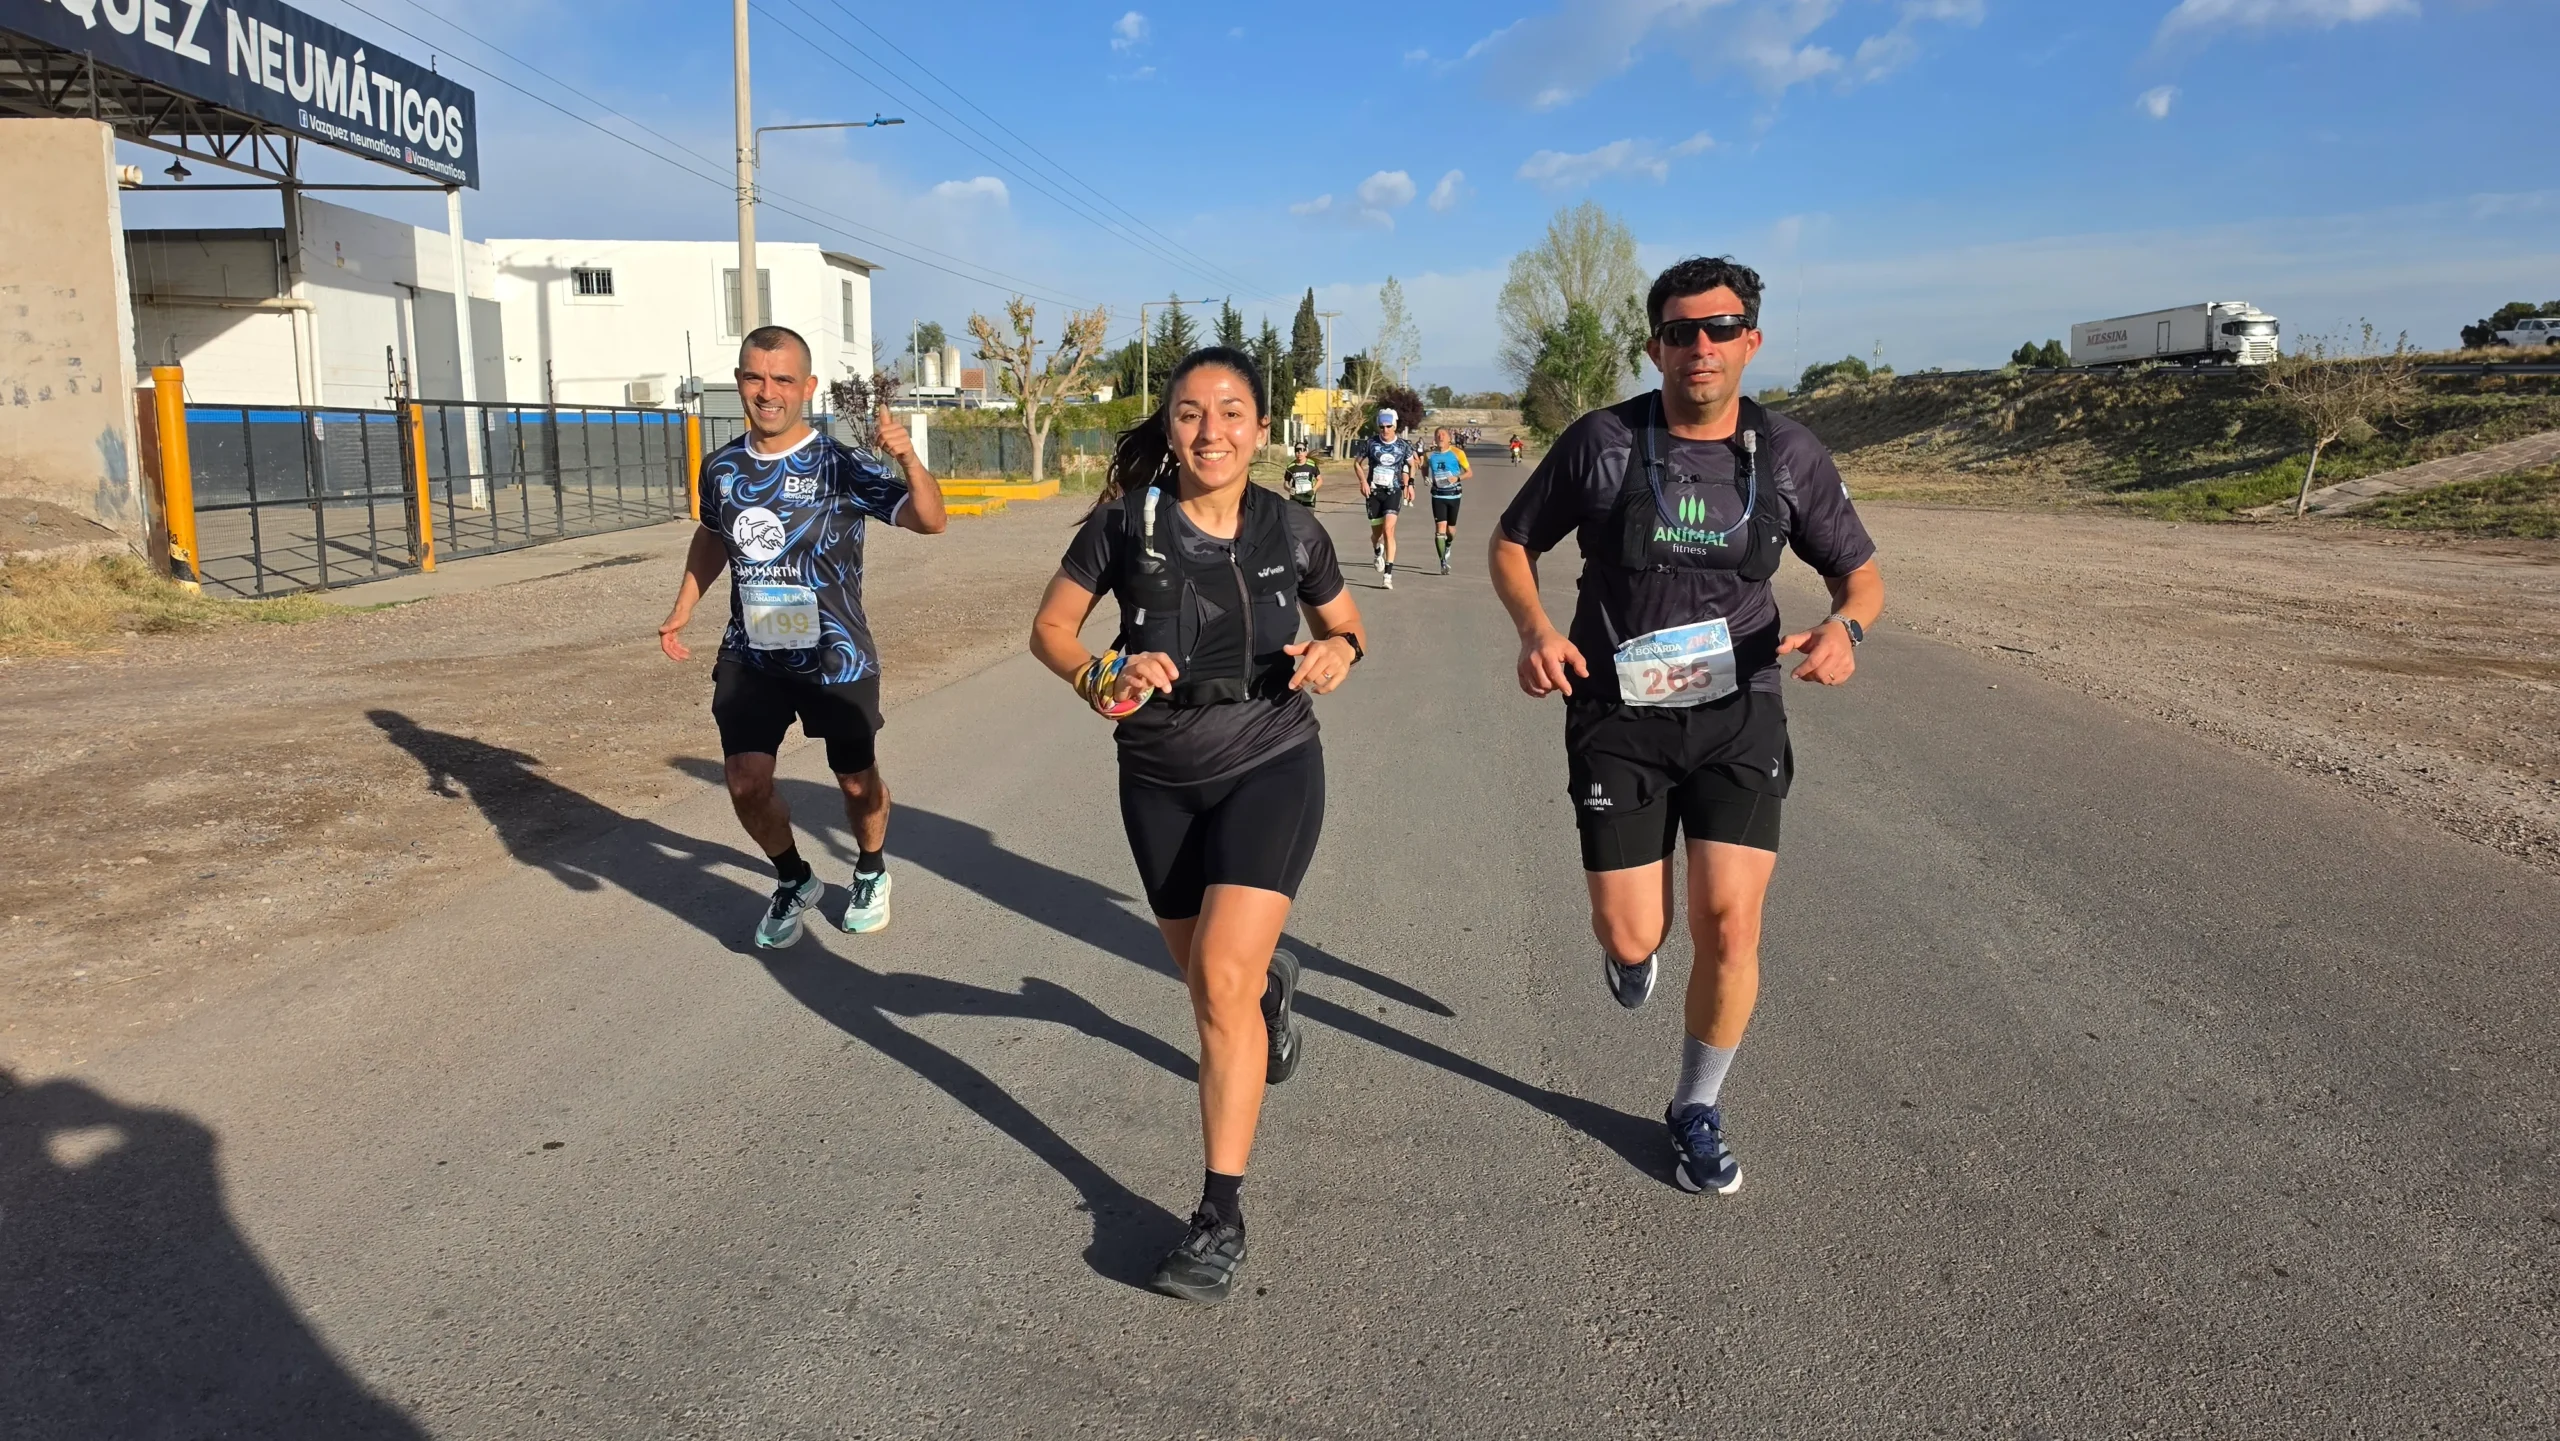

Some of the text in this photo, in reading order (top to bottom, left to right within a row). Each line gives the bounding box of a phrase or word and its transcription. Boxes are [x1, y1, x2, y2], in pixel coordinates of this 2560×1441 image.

[227, 8, 464, 158] NEUMÁTICOS
[309, 113, 401, 159] Vazquez neumaticos
[2086, 329, 2128, 346] MESSINA
[1653, 526, 1729, 547] ANIMAL
[1672, 543, 1707, 556] fitness
[735, 564, 802, 578] SAN MARTÍN
[1635, 643, 1683, 656] BONARDA
[1642, 661, 1713, 695] 265
[1583, 798, 1614, 806] ANIMAL
